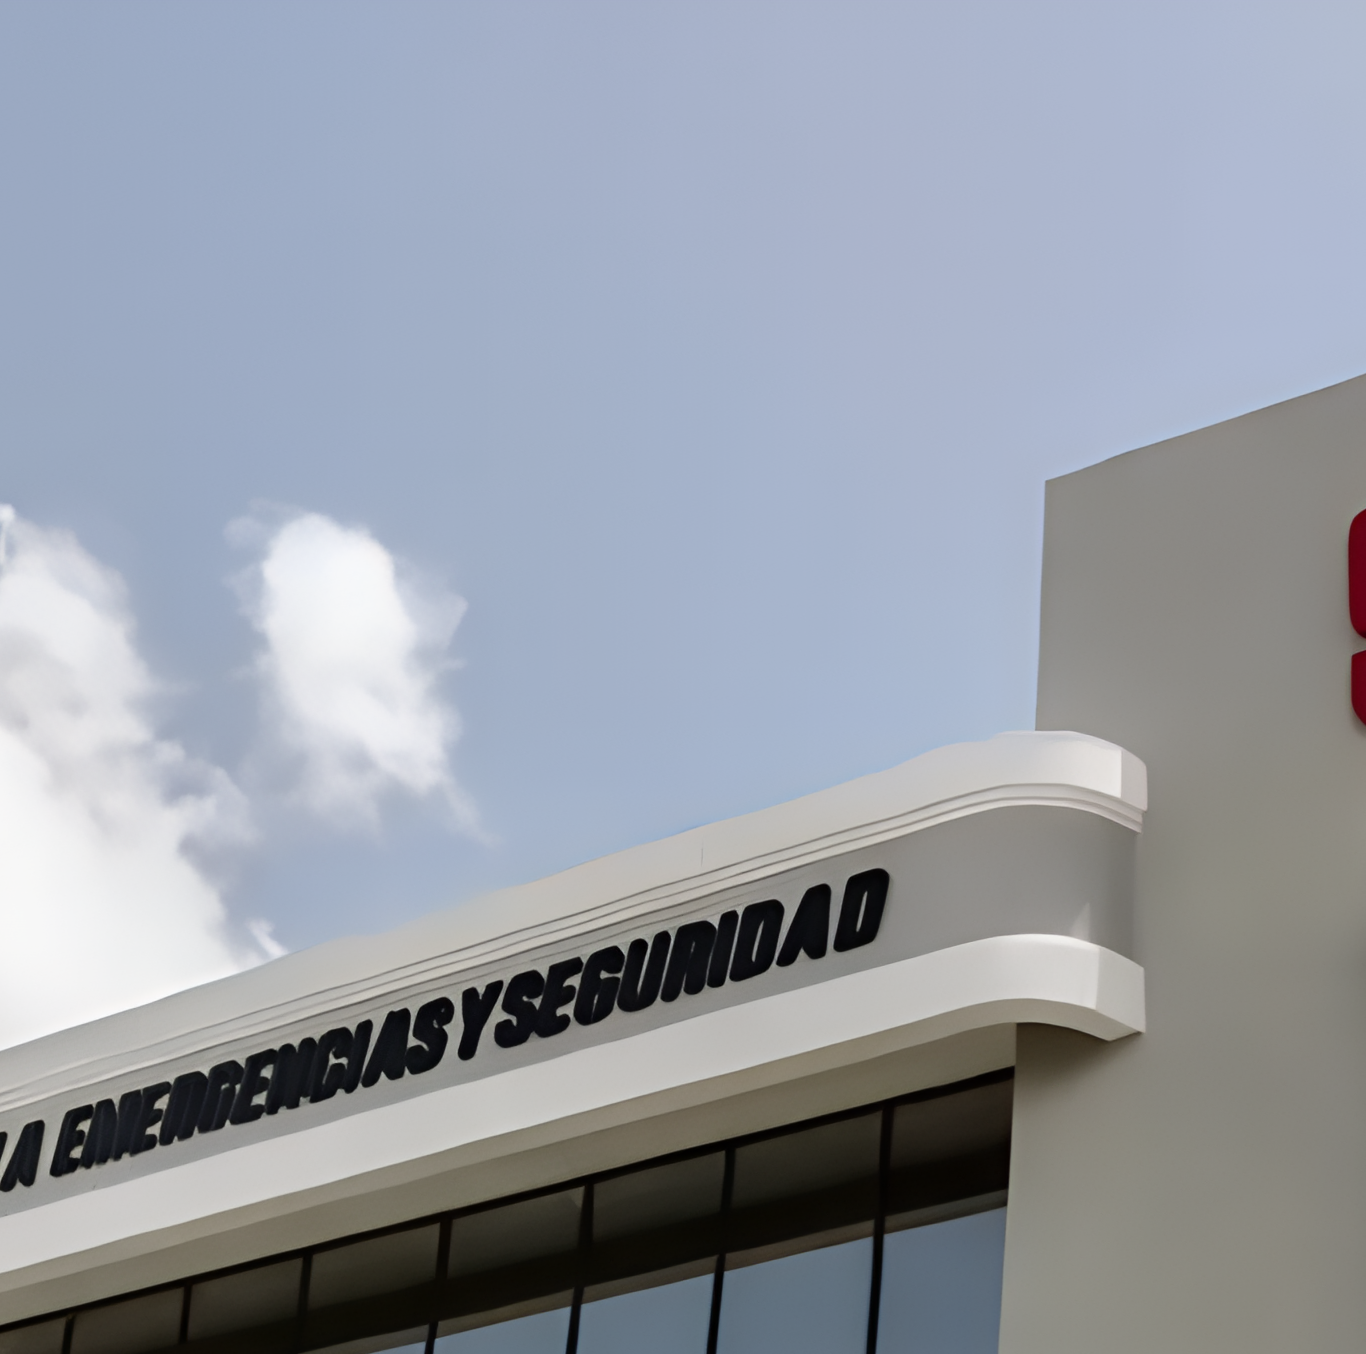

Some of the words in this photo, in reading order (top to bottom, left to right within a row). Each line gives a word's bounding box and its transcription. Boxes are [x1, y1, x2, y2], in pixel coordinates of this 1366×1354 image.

[49, 997, 455, 1177] EMERGENCIAS
[457, 980, 504, 1061] Y
[494, 868, 890, 1049] SEGURIDAD
